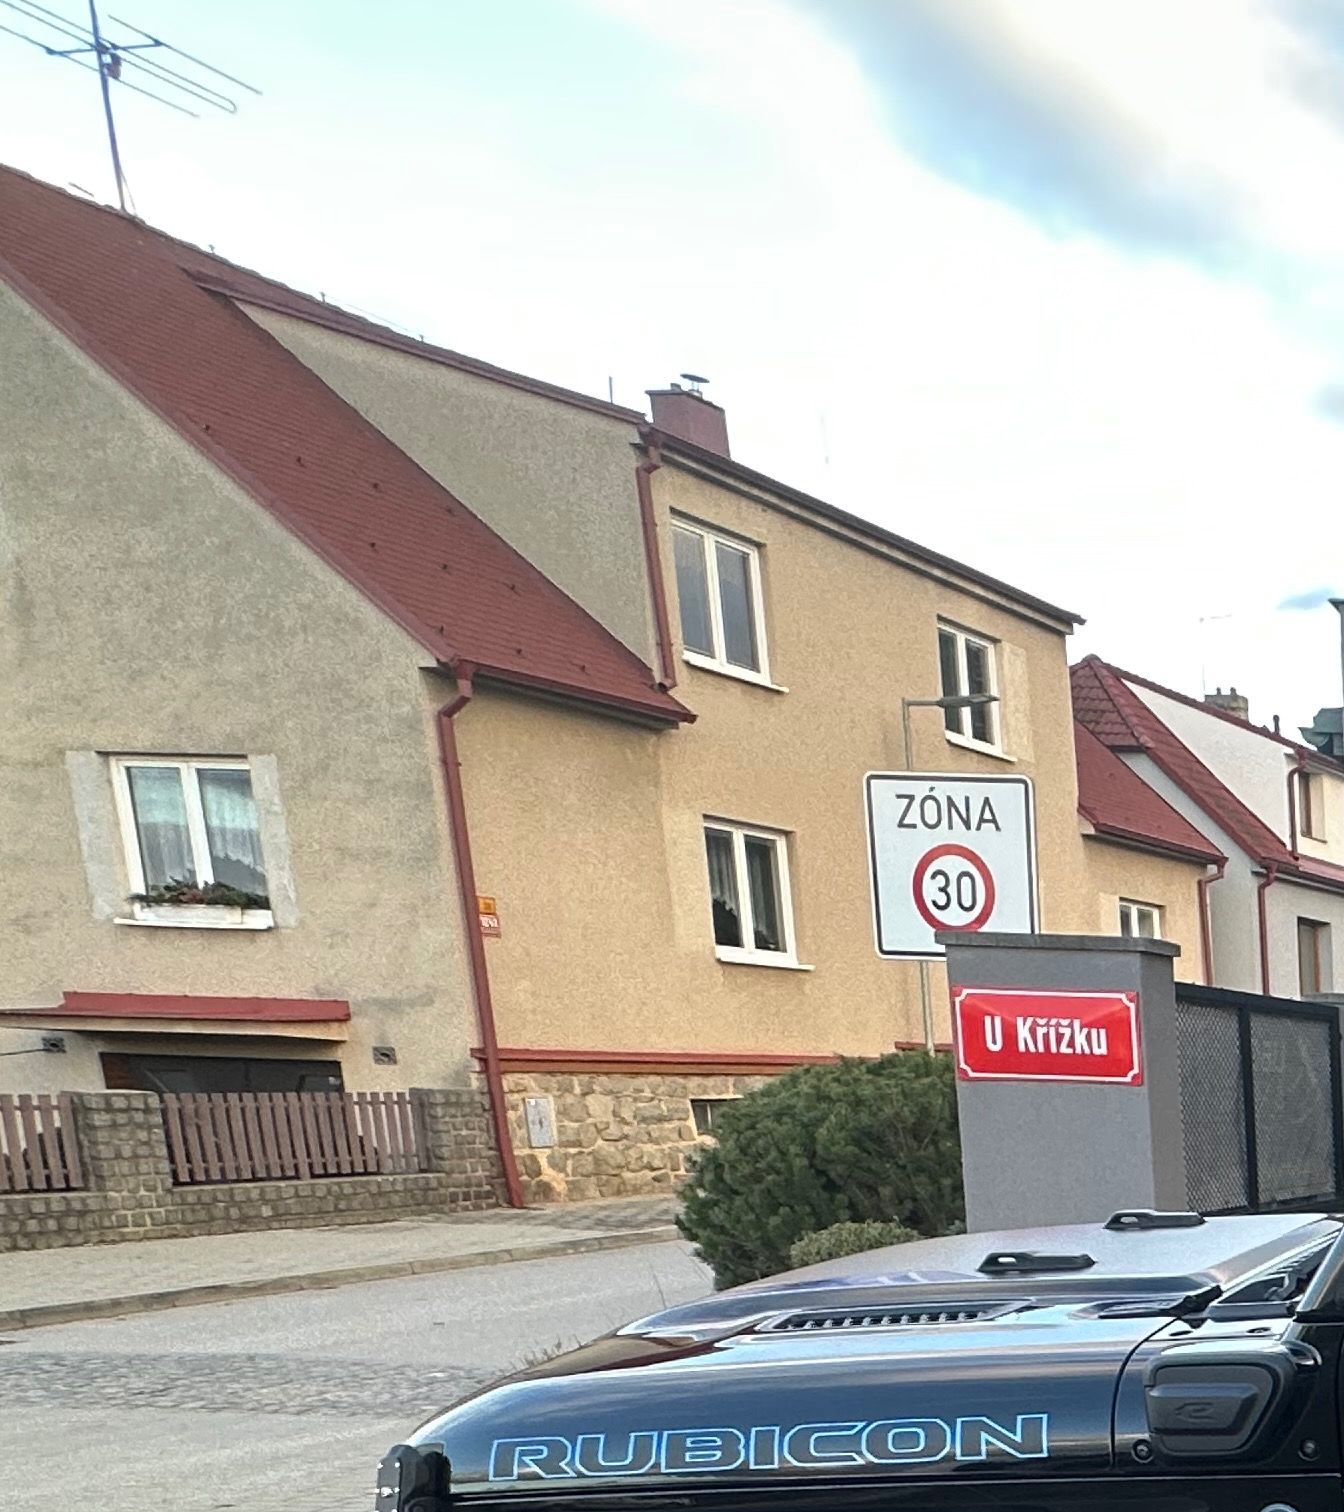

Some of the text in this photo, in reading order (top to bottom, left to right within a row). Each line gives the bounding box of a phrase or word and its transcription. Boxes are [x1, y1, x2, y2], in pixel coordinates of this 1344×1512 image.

[895, 786, 1001, 832] ZÓNA
[930, 869, 977, 912] 30
[984, 1015, 1108, 1055] U Křížku
[488, 1414, 1049, 1481] RUBICON
